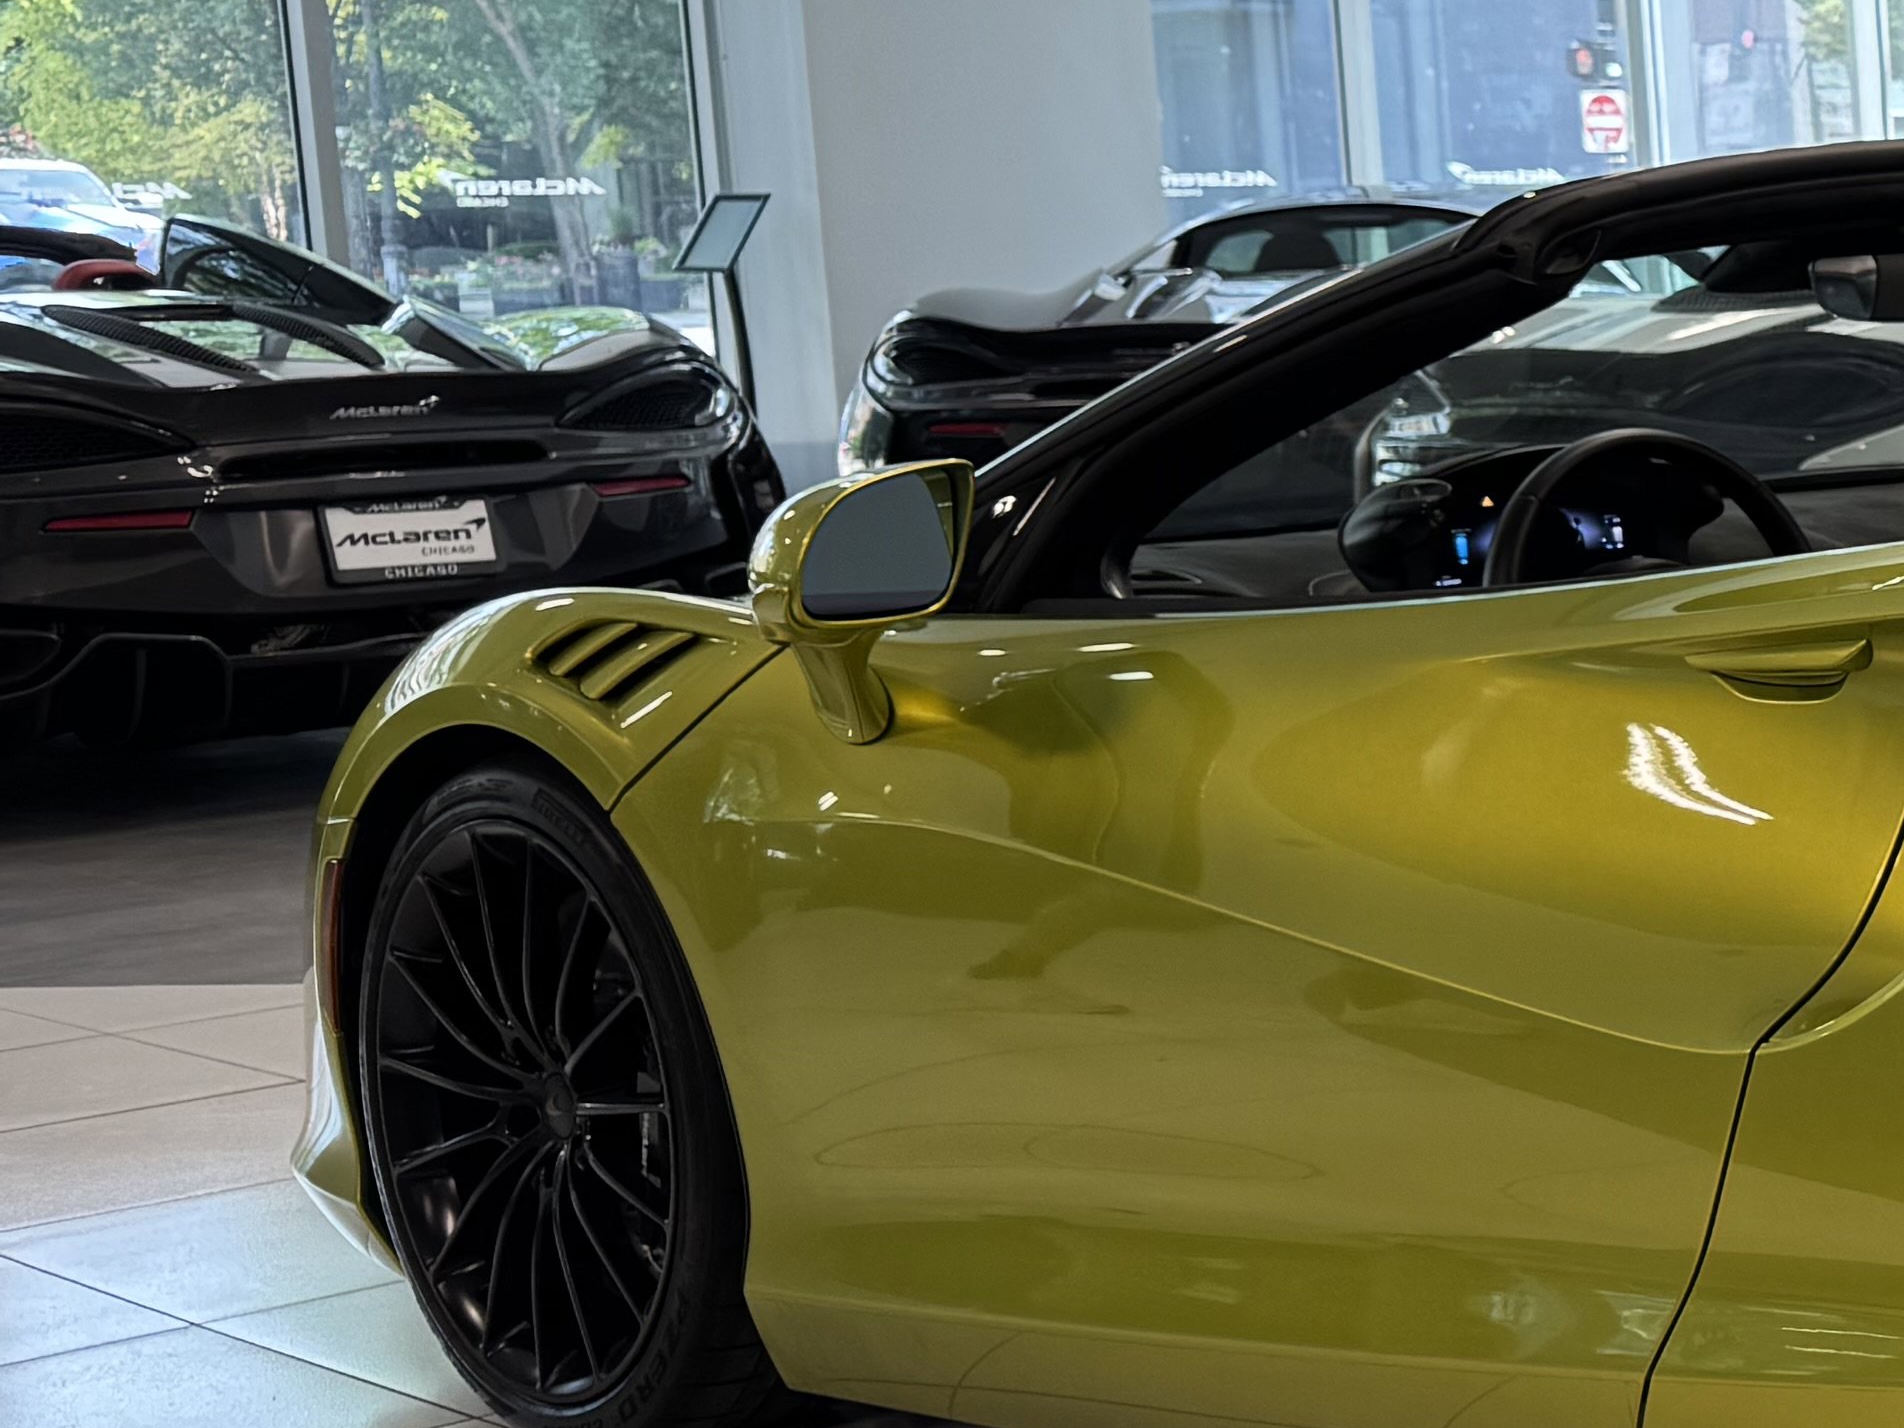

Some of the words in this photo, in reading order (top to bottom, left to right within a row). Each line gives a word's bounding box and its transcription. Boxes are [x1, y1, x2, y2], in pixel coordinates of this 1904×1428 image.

[335, 528, 472, 548] McLaren
[421, 545, 475, 557] CHICAGO
[384, 563, 458, 580] CHICAGO
